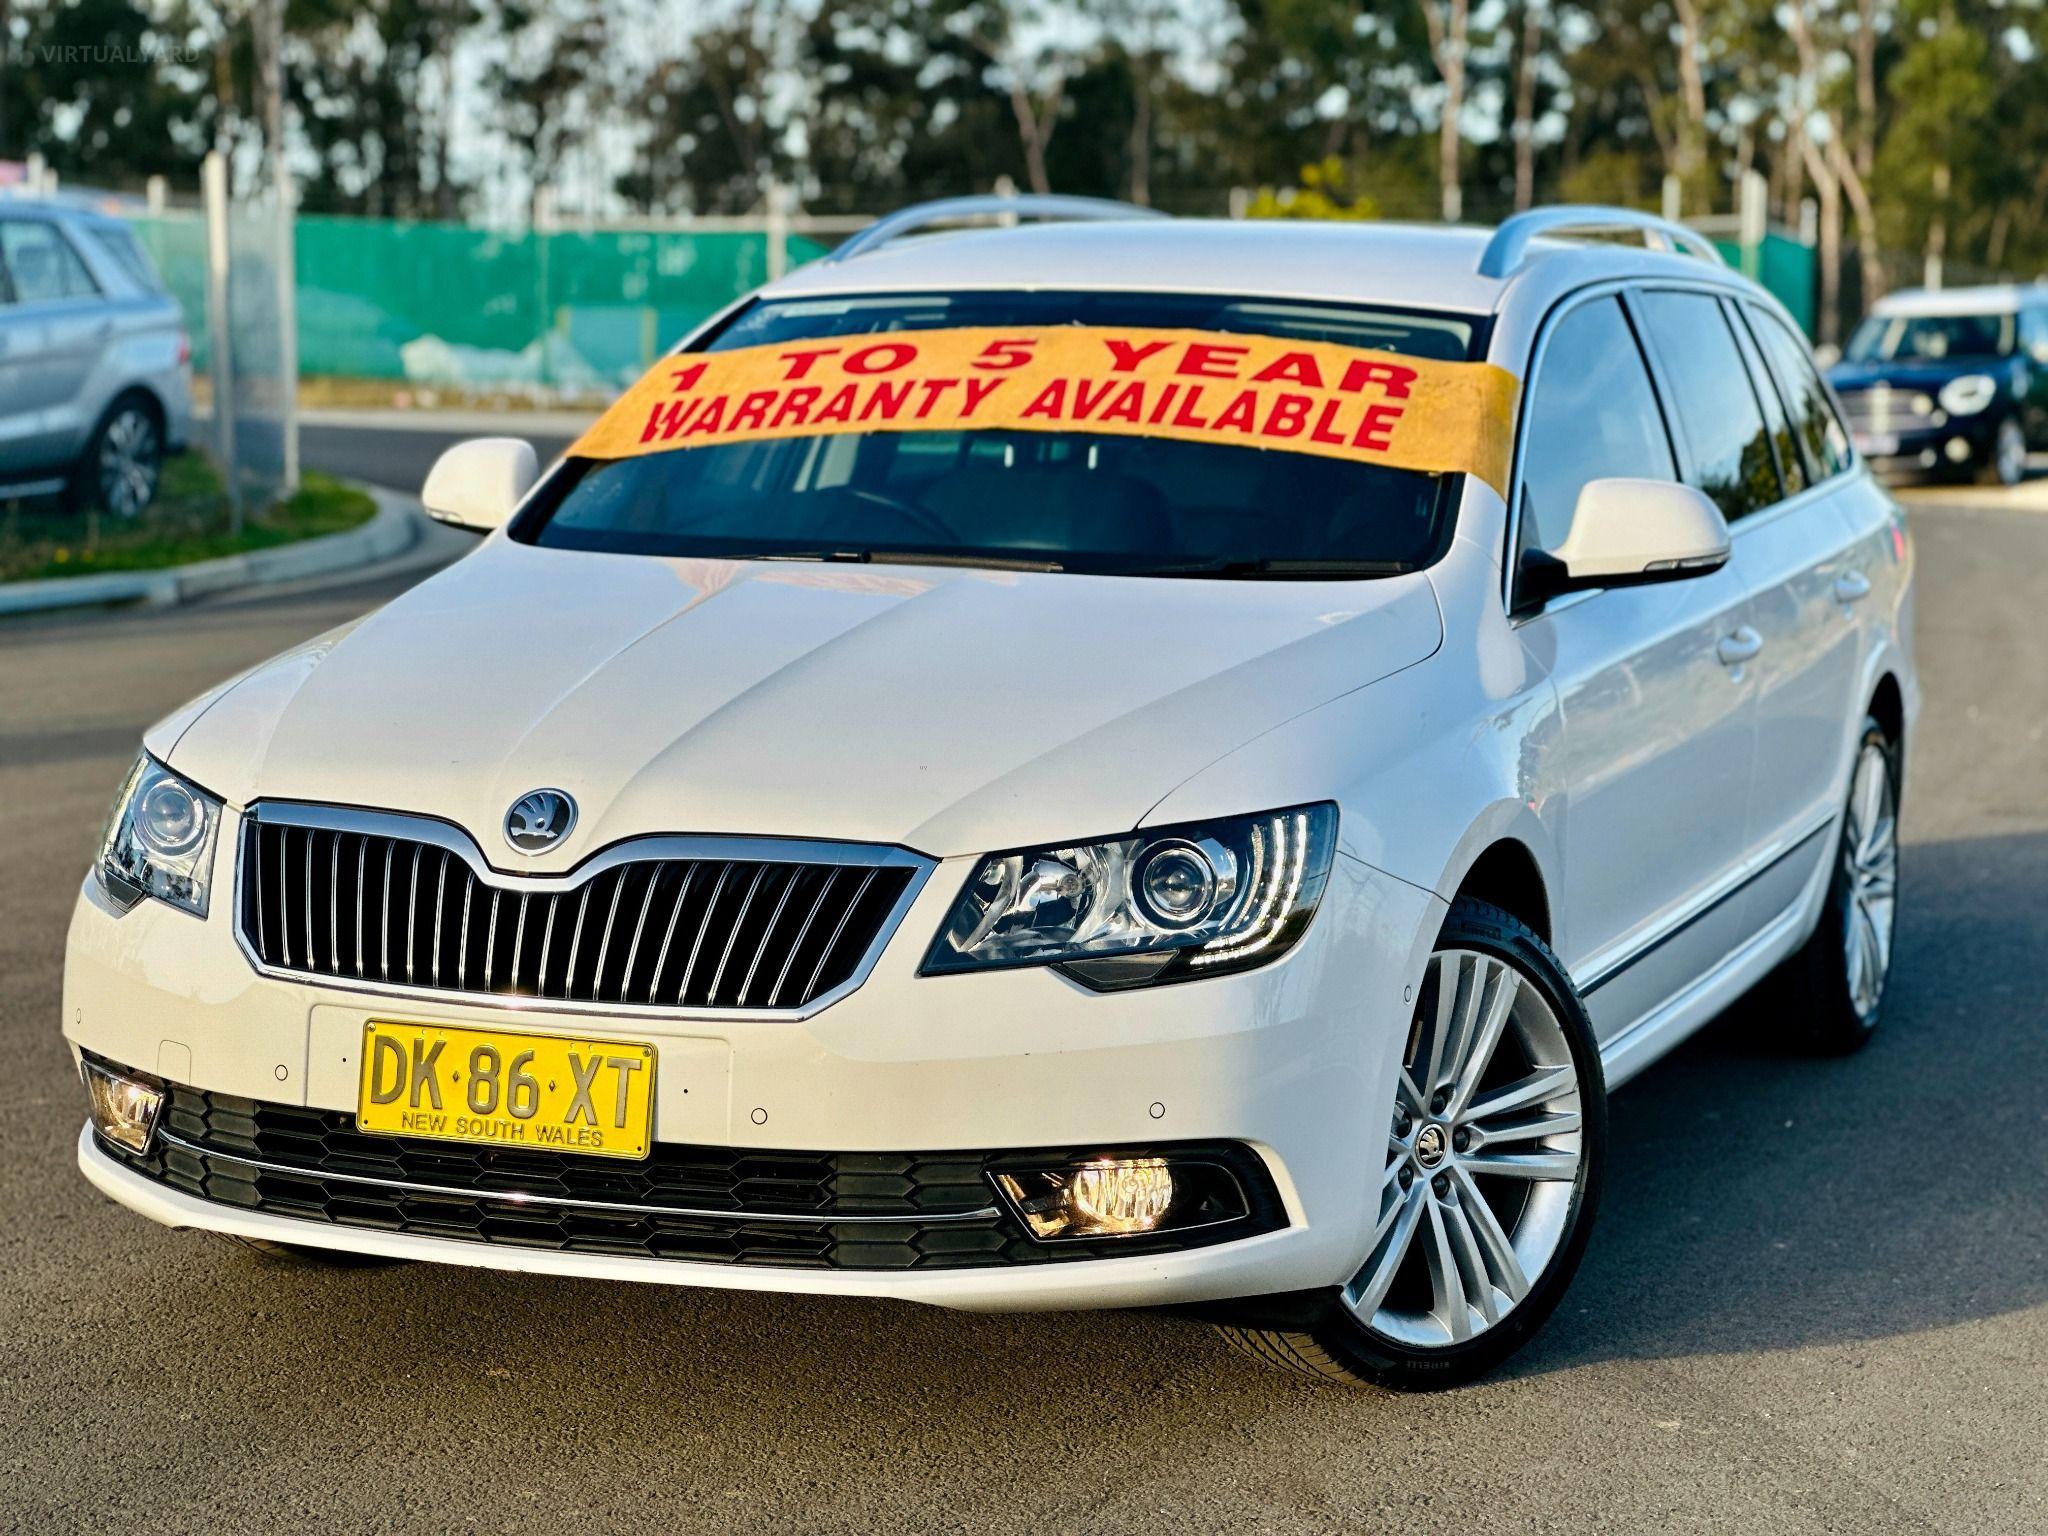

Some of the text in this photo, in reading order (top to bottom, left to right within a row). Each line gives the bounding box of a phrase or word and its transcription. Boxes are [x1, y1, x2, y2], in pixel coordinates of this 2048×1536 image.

[671, 339, 1418, 400] 1 TO 5 YEAR
[638, 377, 1405, 452] WARRANTY AVAILABLE
[370, 1034, 642, 1128] DK 86 XT
[401, 1111, 603, 1148] NEW SOUTH WALES
